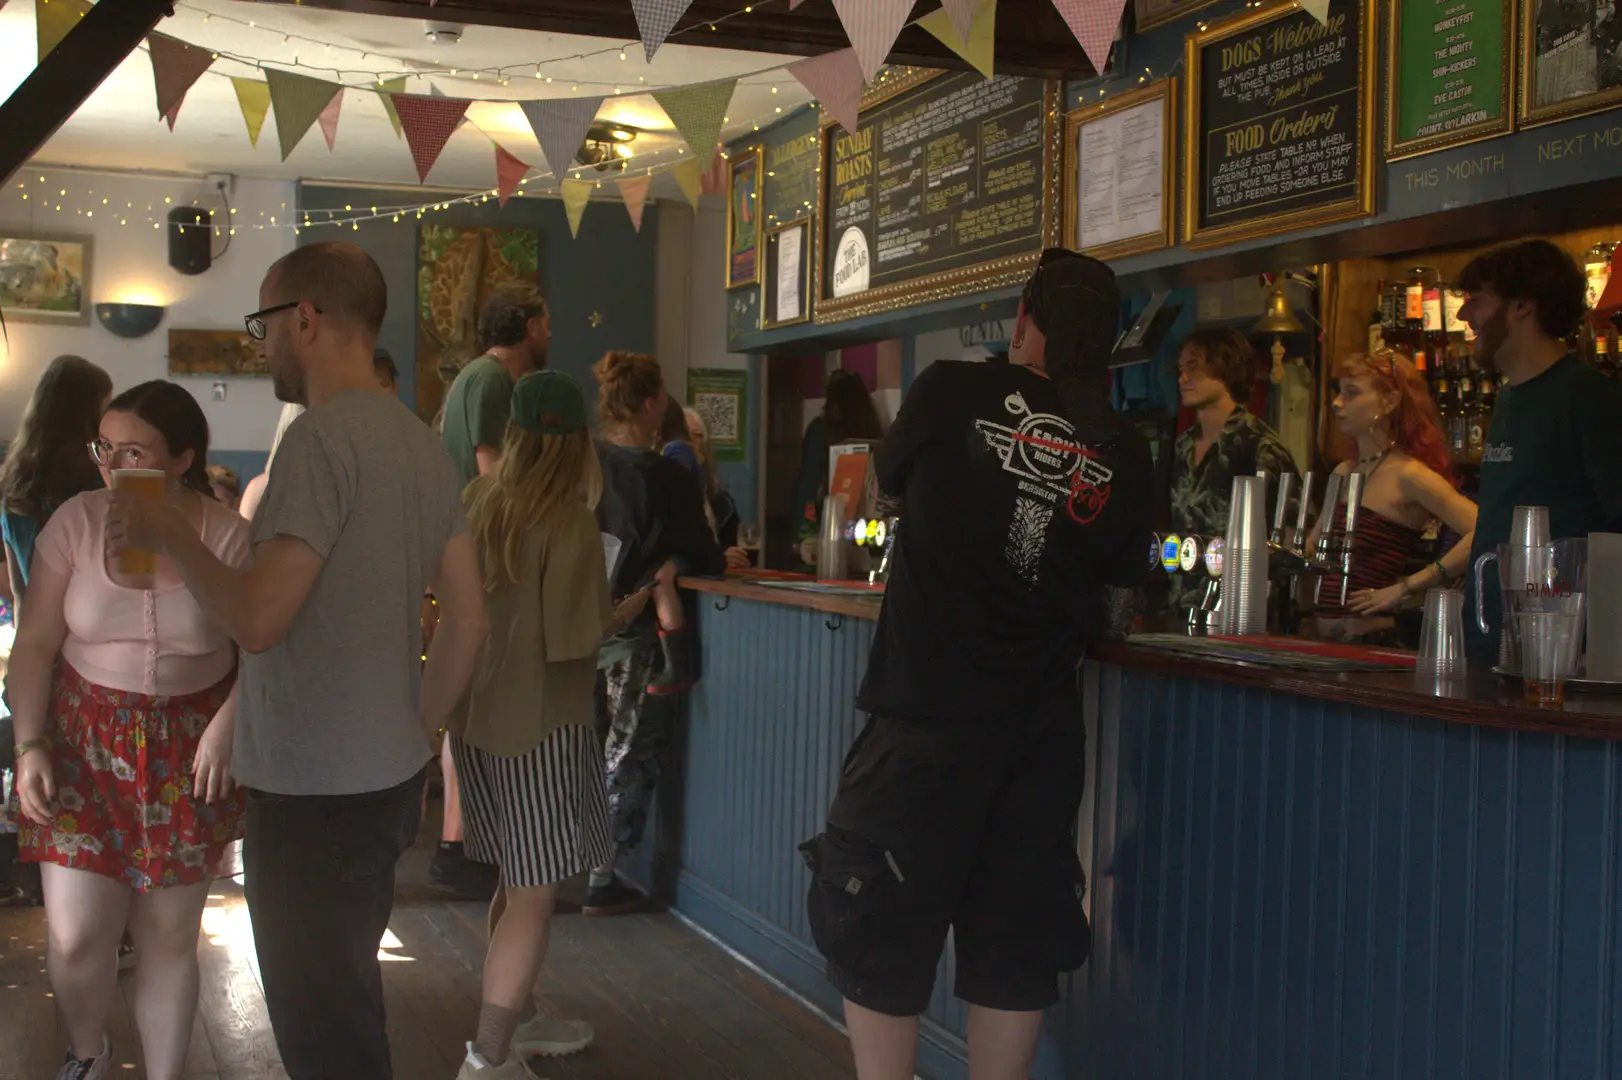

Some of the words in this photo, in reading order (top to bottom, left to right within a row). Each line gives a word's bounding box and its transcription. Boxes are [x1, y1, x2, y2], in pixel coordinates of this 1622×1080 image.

[1218, 78, 1233, 89] BUT
[1234, 70, 1255, 83] MUST
[1257, 65, 1268, 76] BE
[1269, 57, 1290, 72] KEPT
[1293, 52, 1304, 63] ON
[1305, 50, 1311, 59] A
[1313, 42, 1335, 57] LEAD
[1336, 36, 1347, 50] AT
[1222, 36, 1262, 72] DOGS
[1434, 46, 1448, 60] THE
[1450, 40, 1473, 56] MIGHTY
[1222, 86, 1236, 98] ALL
[1240, 78, 1264, 92] TIMES
[1265, 70, 1291, 85] INSIDE
[1293, 65, 1304, 76] OR
[1306, 51, 1341, 72] OUTSIDE
[1432, 57, 1477, 78] SHIN-KICKERS
[1238, 93, 1252, 103] THE
[835, 125, 874, 158] SUNDAY
[1219, 155, 1252, 173] PLEASE
[1255, 148, 1276, 165] STATE
[1280, 143, 1303, 158] TABLE
[1319, 133, 1345, 147] WHEN
[1225, 124, 1264, 157] FOOD
[1538, 134, 1587, 162] NEXT
[836, 151, 872, 186] ROASTS
[1211, 165, 1248, 186] ORDERING
[1251, 160, 1272, 176] FOOD
[1274, 156, 1290, 171] AND
[1292, 148, 1322, 167] INFORM
[1325, 143, 1353, 158] STAFF
[1213, 184, 1220, 195] IF
[1222, 180, 1237, 192] YOU
[1239, 174, 1260, 188] MOVE
[1263, 167, 1292, 184] TABLES
[1312, 159, 1329, 174] YOU
[1331, 155, 1350, 166] MAY
[1405, 167, 1439, 191] THIS
[1446, 153, 1504, 180] MONTH
[1216, 195, 1231, 207] END
[1233, 191, 1243, 202] UP
[1245, 182, 1278, 201] FEEDING
[1280, 173, 1319, 193] SOMEONE
[844, 241, 856, 260] THE
[835, 264, 852, 288] FOOD
[852, 250, 867, 274] LAB
[1033, 450, 1062, 469] RIDERS
[1525, 578, 1572, 598] PIMM'S
